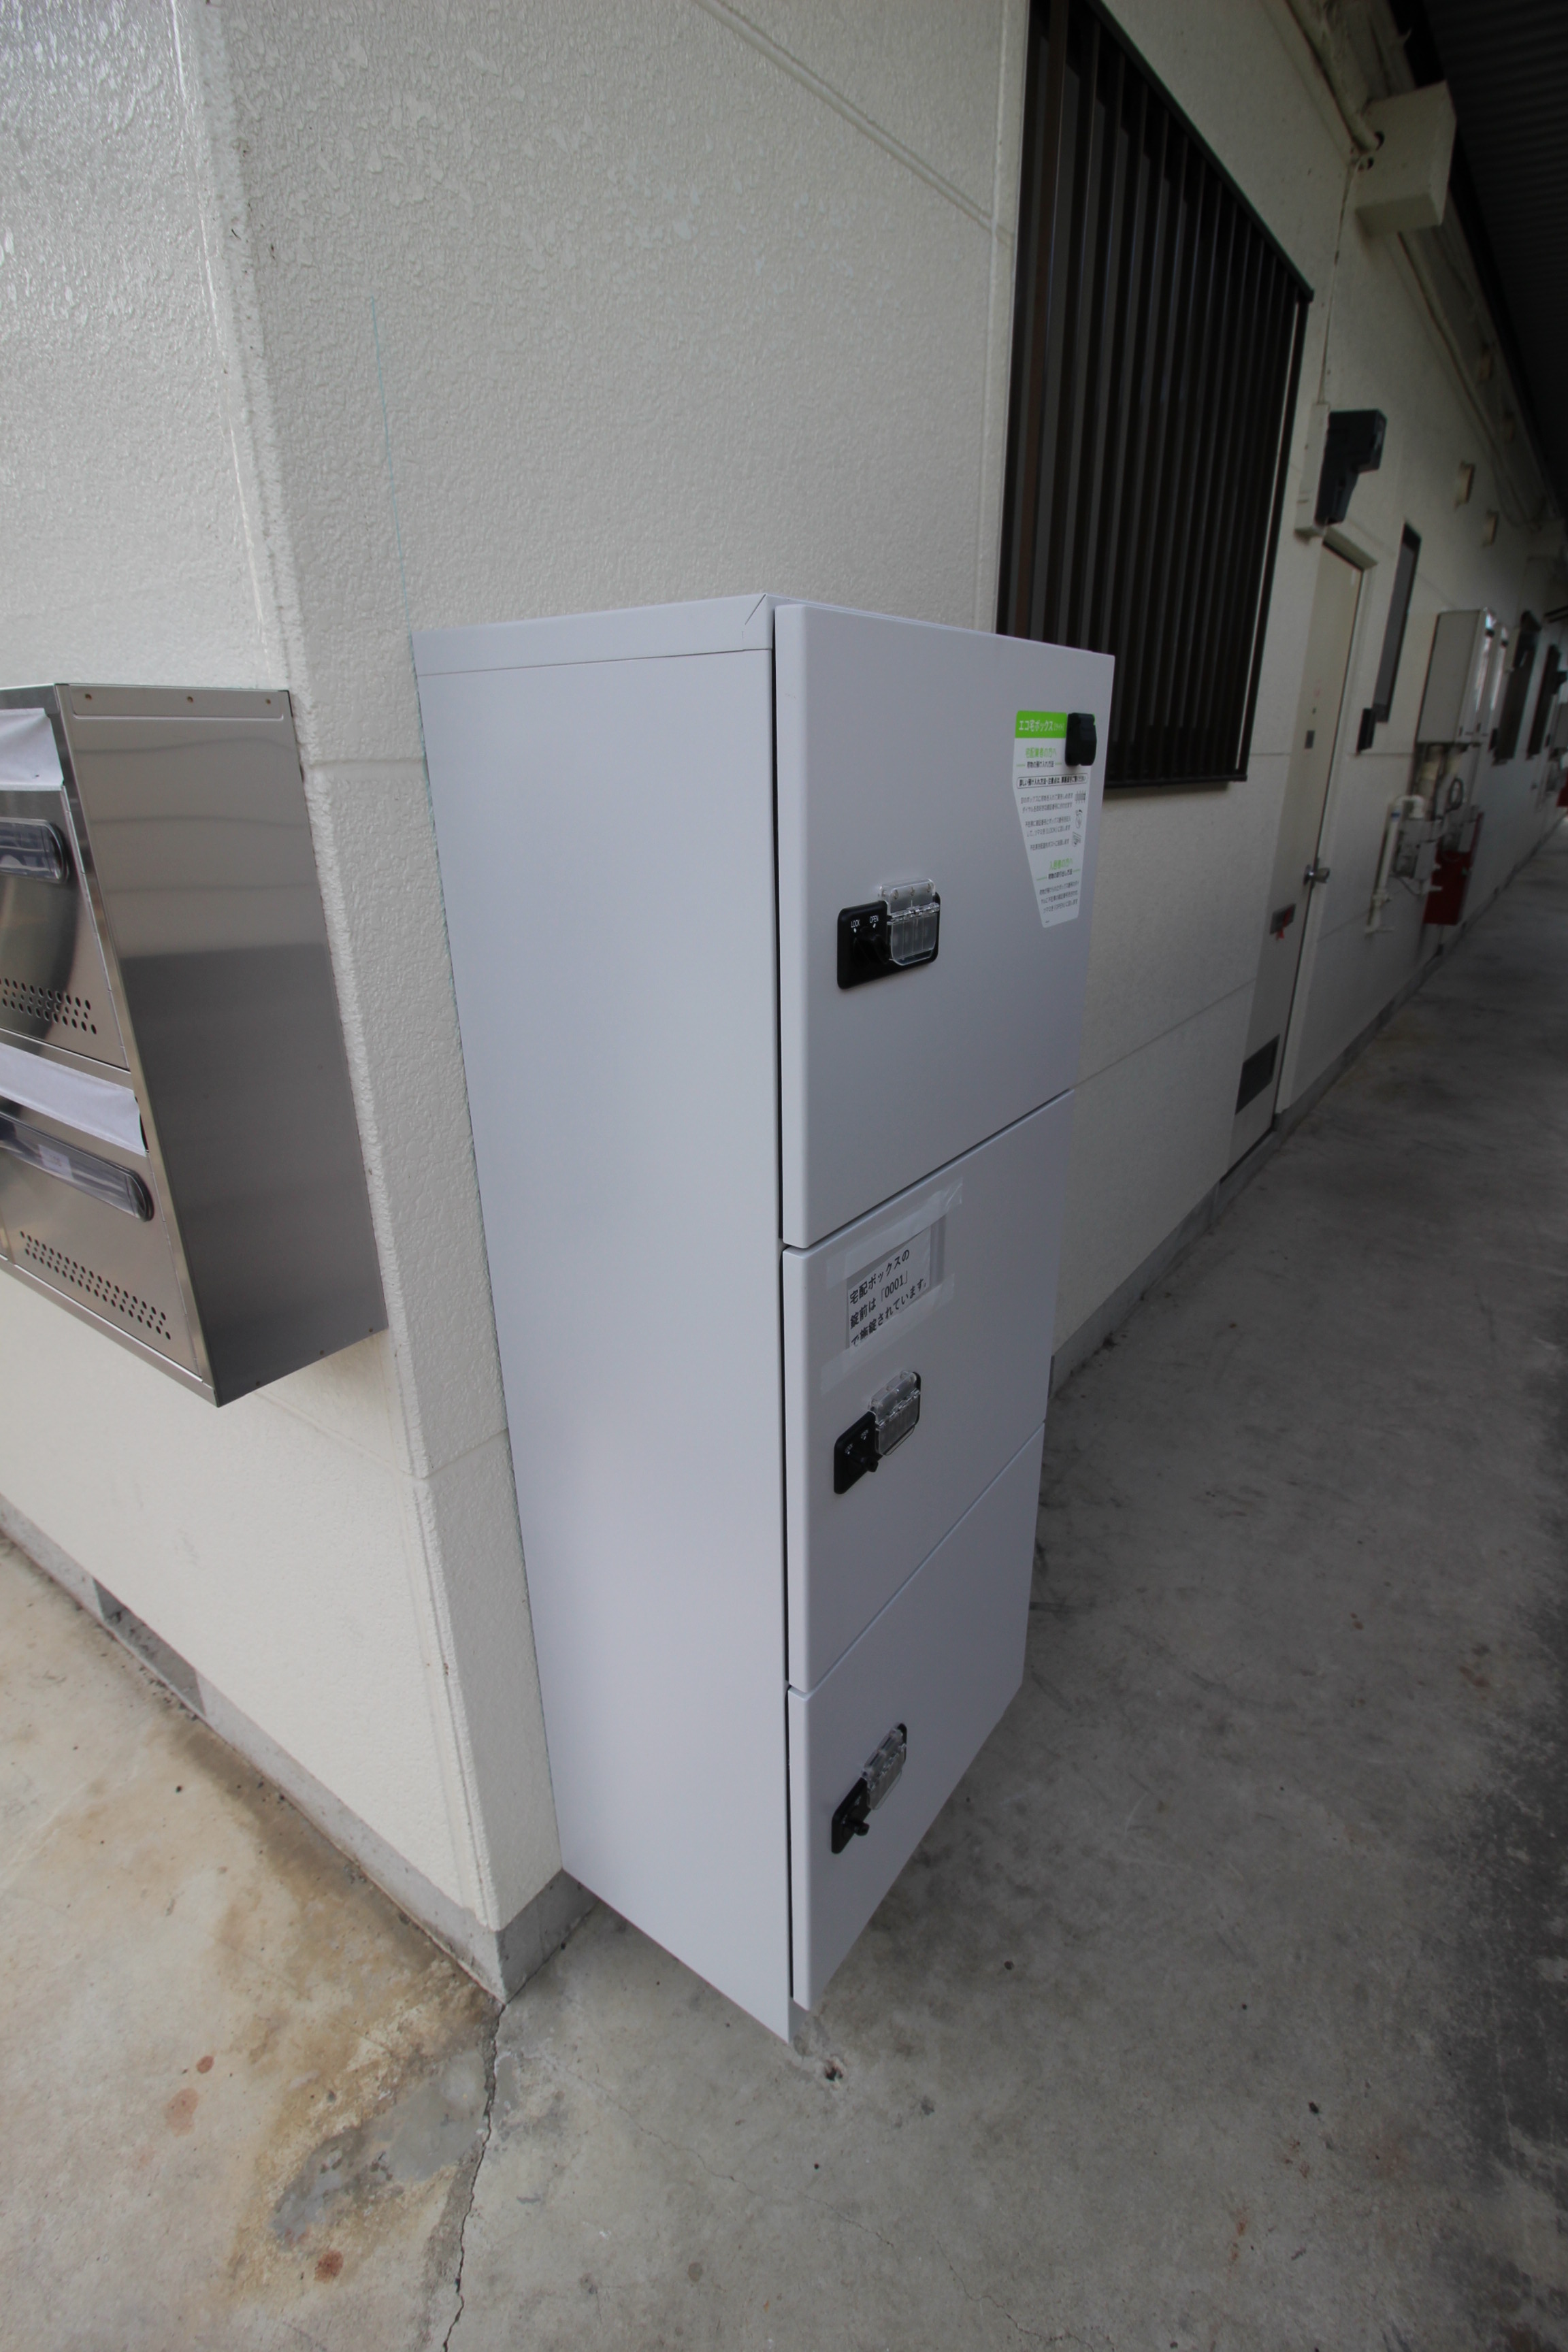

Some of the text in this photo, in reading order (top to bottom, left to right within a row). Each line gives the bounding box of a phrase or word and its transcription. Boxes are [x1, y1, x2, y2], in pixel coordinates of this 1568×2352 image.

[870, 915, 879, 924] OPEN
[850, 1250, 910, 1305] 宅配ボックスの
